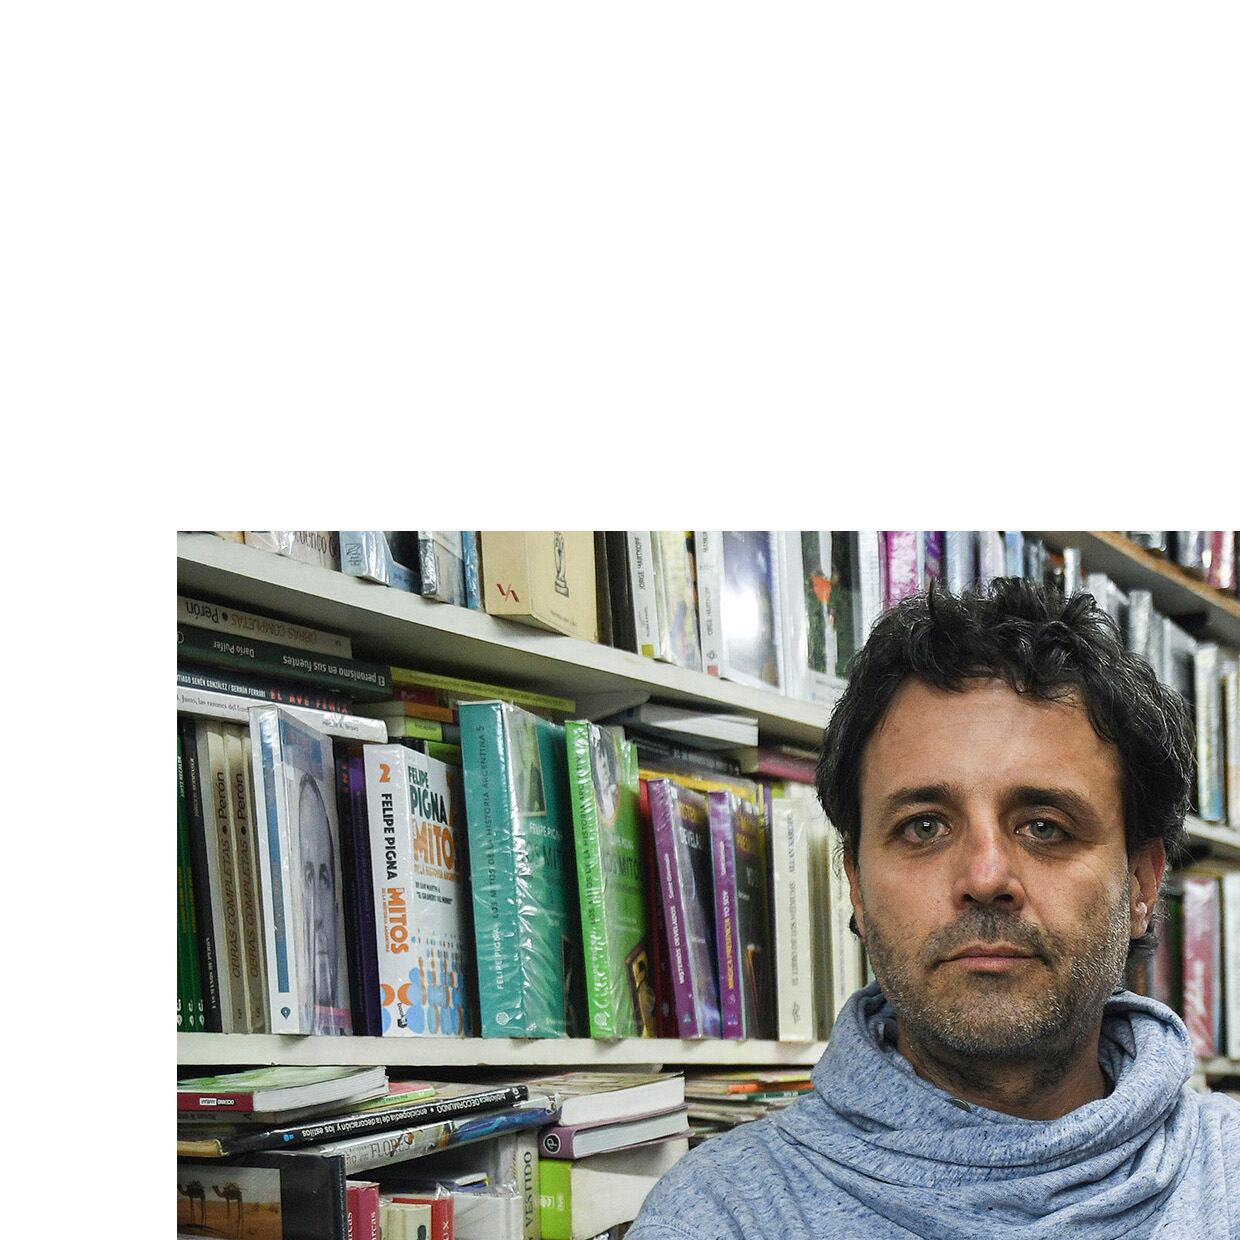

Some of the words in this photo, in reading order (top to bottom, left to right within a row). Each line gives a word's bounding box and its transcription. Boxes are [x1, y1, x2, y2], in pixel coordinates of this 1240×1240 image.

[186, 600, 220, 624] Perón
[214, 641, 233, 655] Pulfer
[283, 656, 311, 671] fuentes
[312, 661, 327, 672] sus
[328, 666, 338, 675] en
[338, 667, 376, 684] peronismo
[378, 676, 386, 687] El
[379, 764, 391, 783] 2
[408, 765, 430, 790] FELIPE
[479, 735, 490, 789] ARGENTINA
[214, 771, 228, 820] Perón
[233, 773, 247, 820] Perón
[411, 786, 449, 826] PIGNA
[382, 793, 395, 834] FELIPE
[483, 792, 493, 837] HISTORIA
[580, 804, 591, 846] HISTORIA
[386, 835, 397, 881] PIGNA
[413, 819, 458, 871] MITO
[221, 839, 237, 926] COMPLETAS
[239, 839, 255, 925] COMPLETAS
[722, 890, 730, 905] SOY
[387, 887, 409, 955] MITOS
[490, 900, 499, 919] LOS
[670, 905, 681, 946] DEVELADOS
[229, 930, 241, 978] OBRAS
[247, 929, 260, 978] OBRAS
[676, 948, 686, 985] MISTERIOS
[495, 959, 504, 990] FELIPE
[397, 1003, 408, 1029] book
[390, 1109, 429, 1121] enciclopedia
[435, 1097, 481, 1113] DECORMUNDO
[301, 1126, 324, 1137] estilos
[323, 1125, 336, 1135] los
[524, 1151, 534, 1228] VESTIDO
